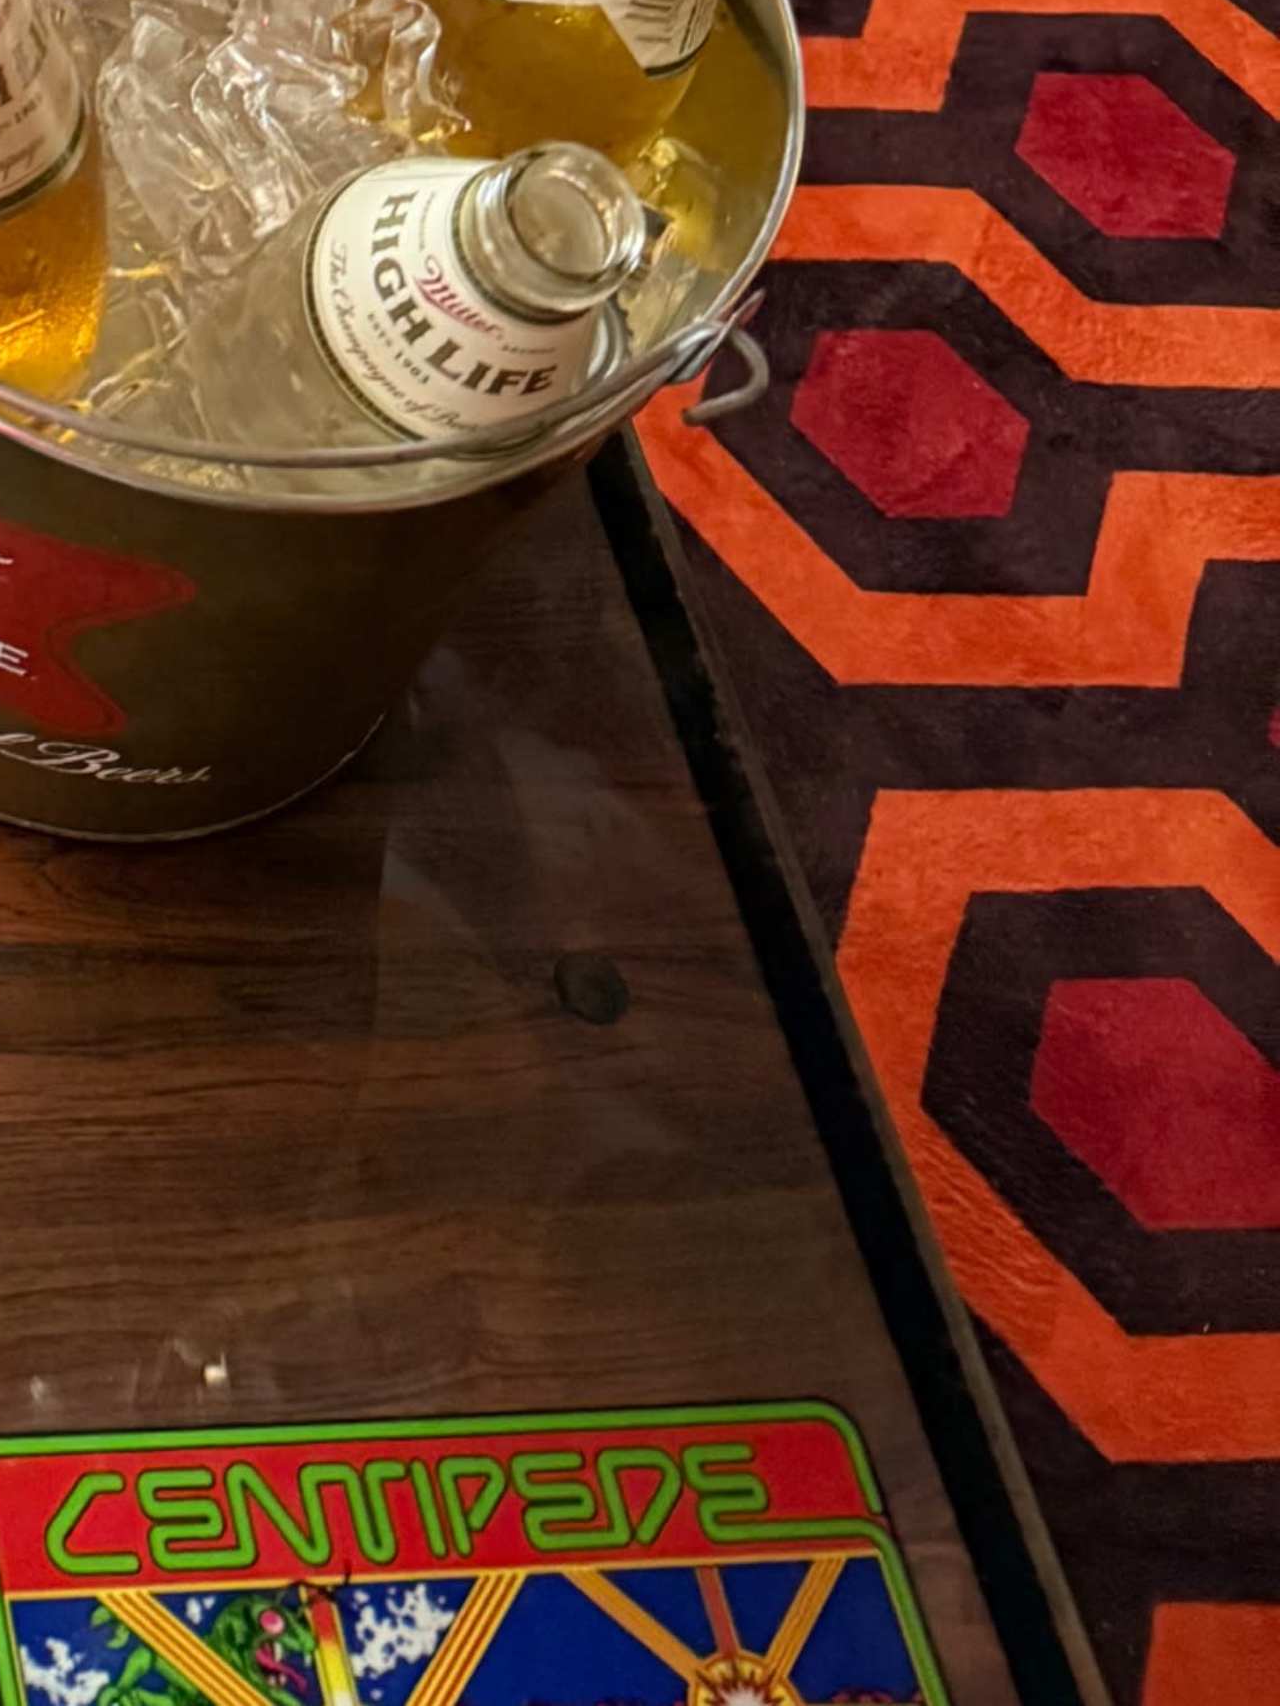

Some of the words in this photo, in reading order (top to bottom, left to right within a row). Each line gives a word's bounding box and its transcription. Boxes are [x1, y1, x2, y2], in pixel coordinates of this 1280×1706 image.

[371, 190, 434, 345] HIGH
[426, 339, 558, 396] LIFE
[414, 254, 503, 339] Miller
[394, 350, 432, 385] 1903
[45, 1442, 772, 1575] CENTIPEDE
